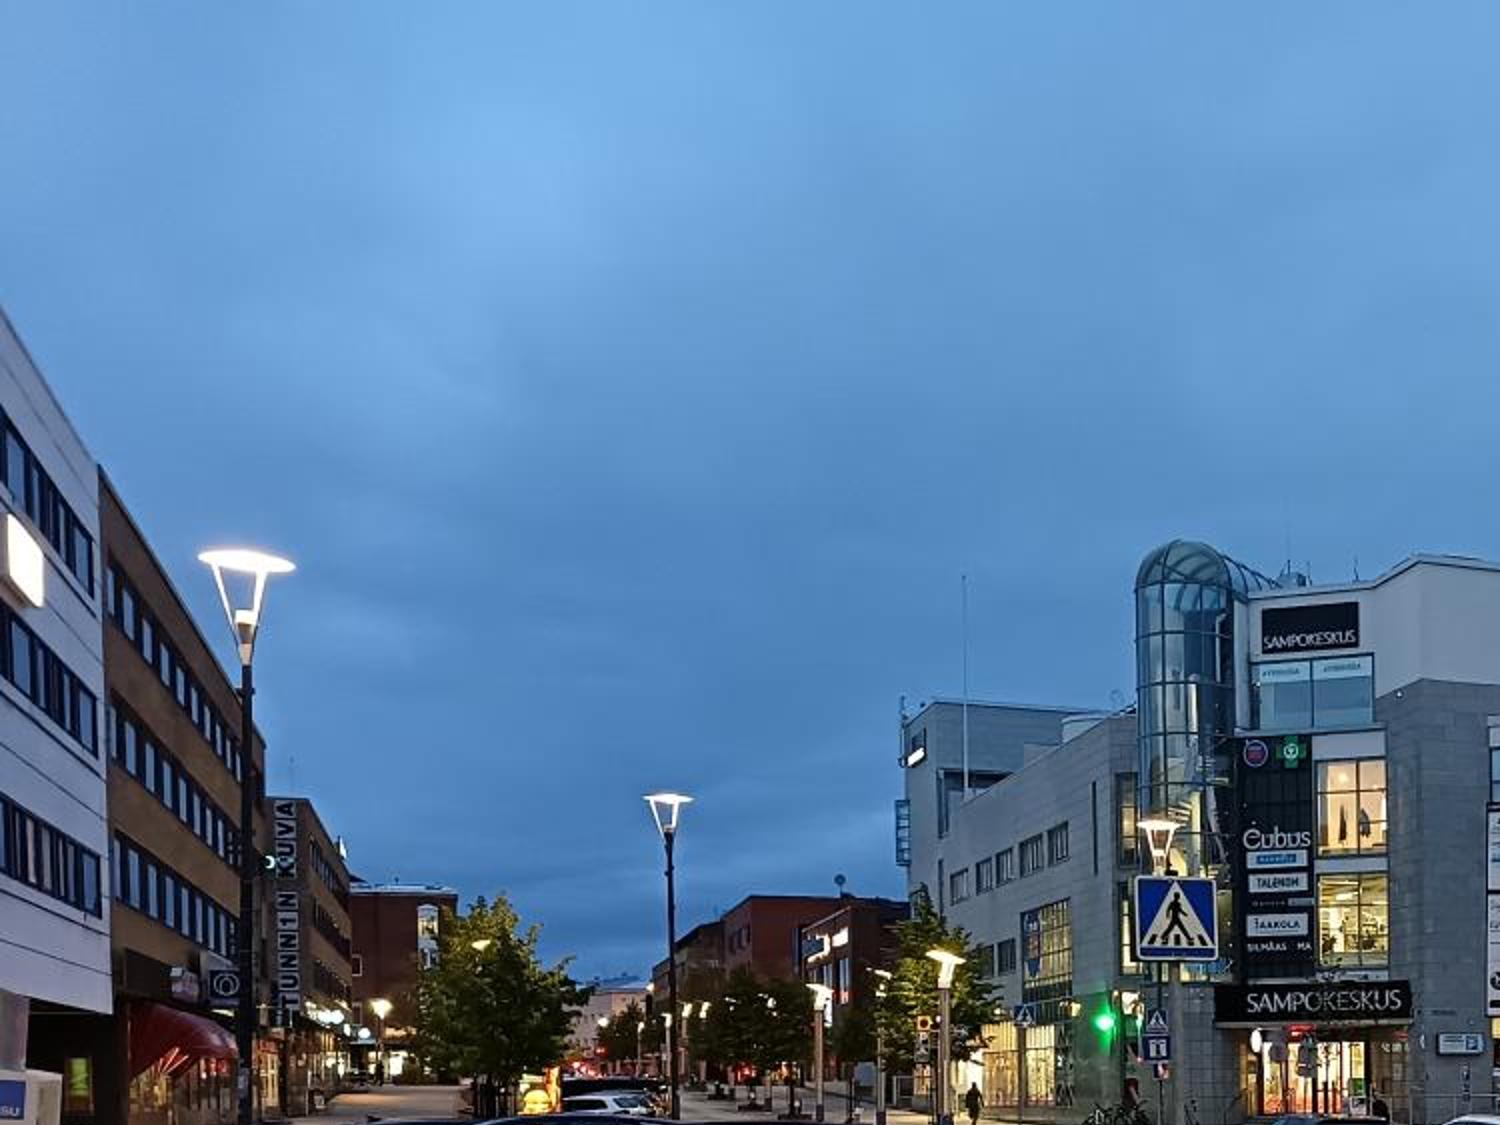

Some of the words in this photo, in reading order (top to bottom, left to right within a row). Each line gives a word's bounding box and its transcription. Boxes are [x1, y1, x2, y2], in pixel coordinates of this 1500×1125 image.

[1263, 629, 1357, 650] SAMPOKESKUS
[275, 801, 297, 878] KUVA
[1247, 988, 1403, 1013] SAMPOKESKUS
